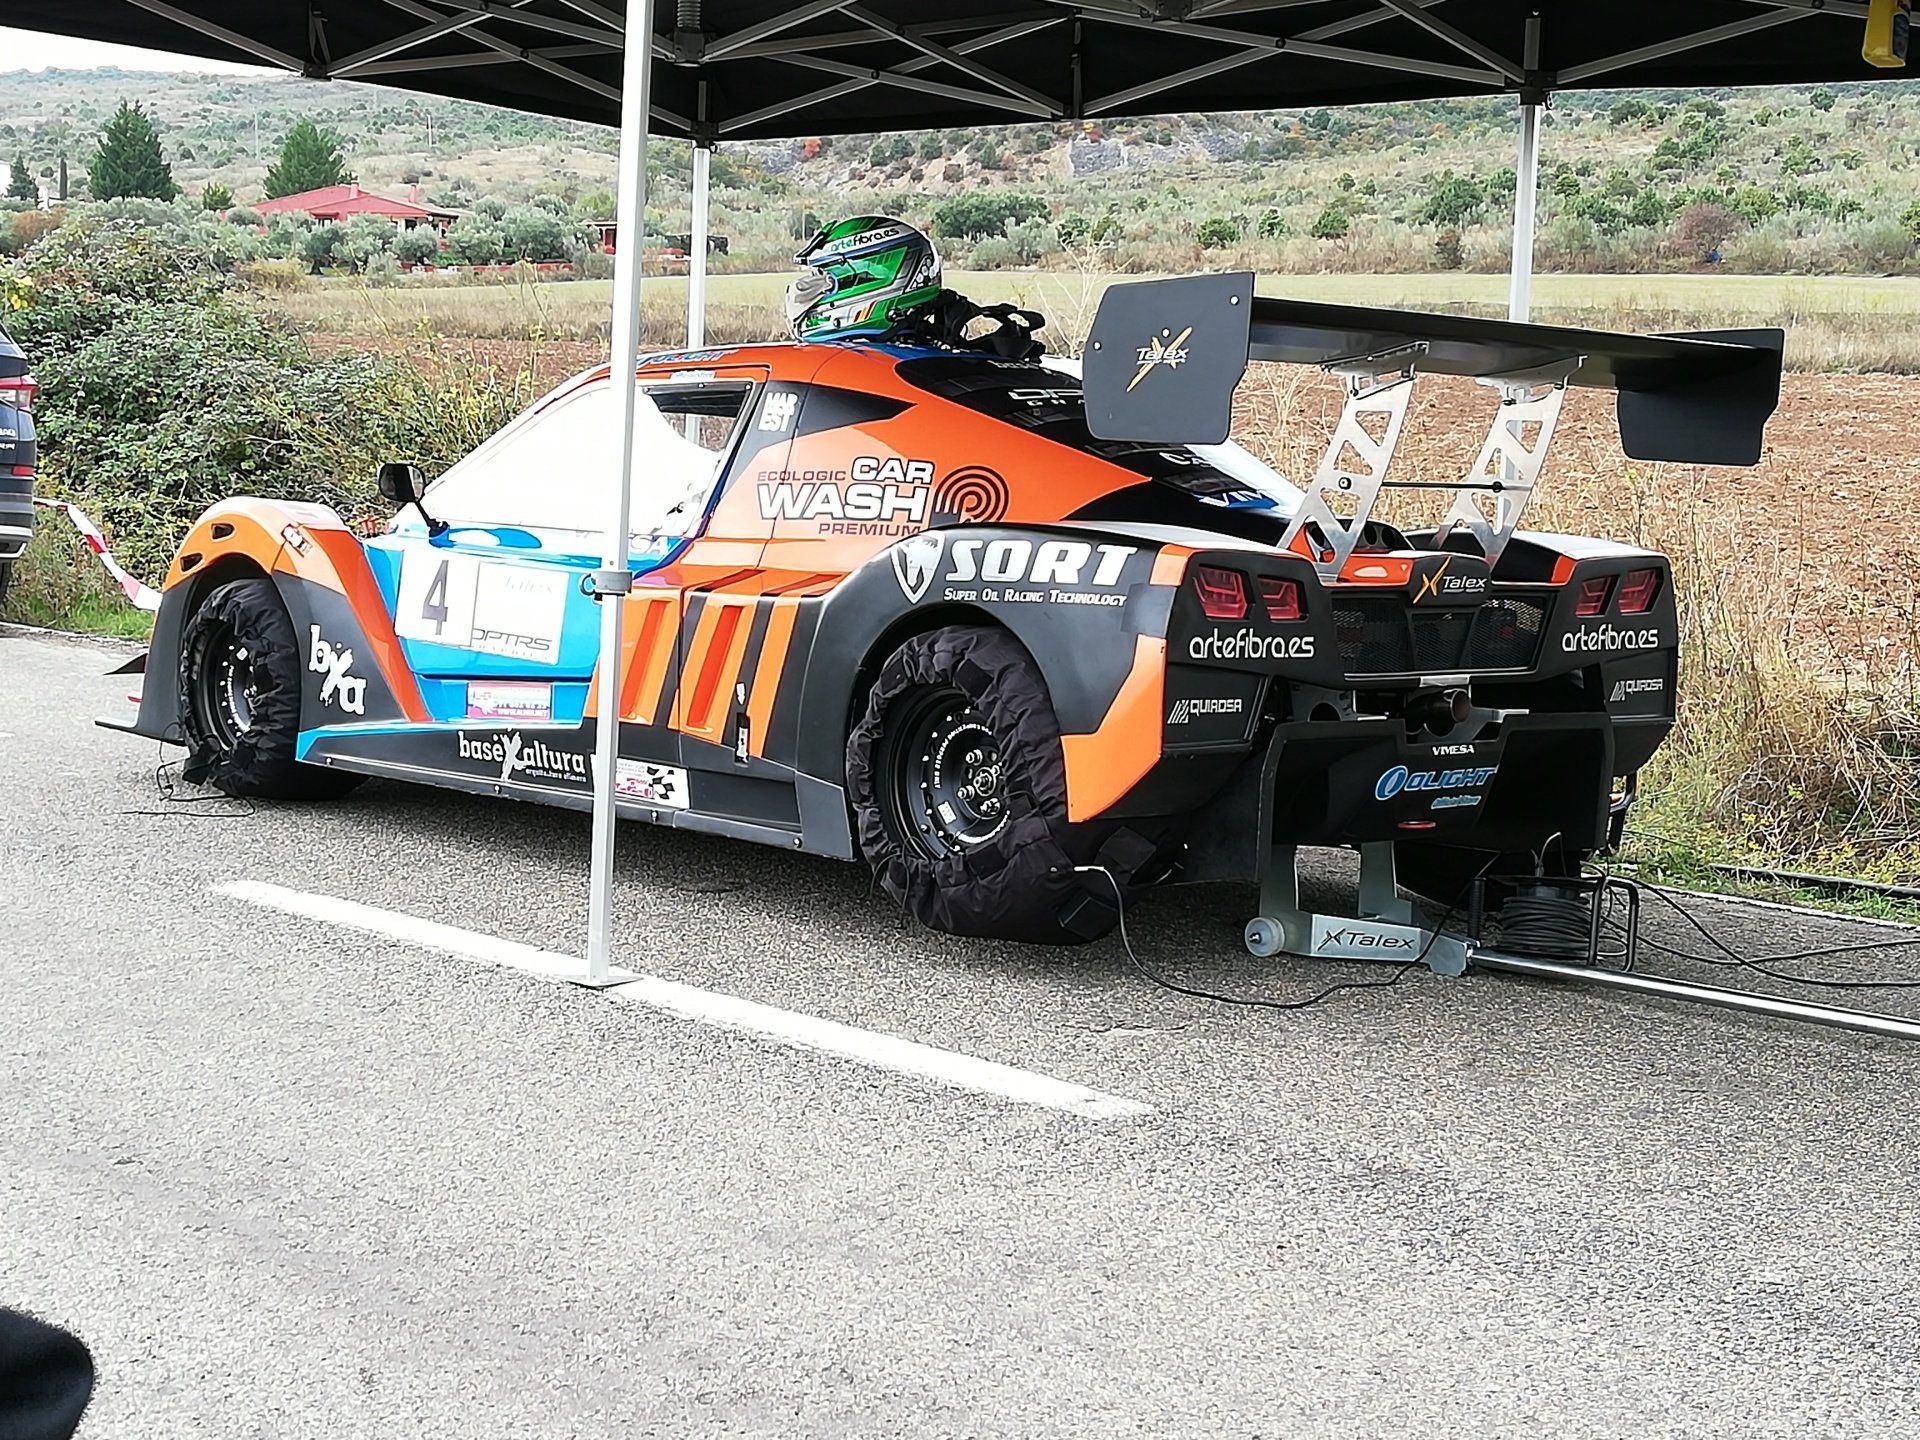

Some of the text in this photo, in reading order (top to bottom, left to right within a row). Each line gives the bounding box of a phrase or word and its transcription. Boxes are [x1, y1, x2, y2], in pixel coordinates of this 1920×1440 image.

[1136, 346, 1190, 362] Talex
[758, 456, 935, 484] ECOLOGIC CAR
[757, 483, 930, 522] WASH
[819, 523, 921, 536] PREMIUM
[945, 539, 1138, 586] SORT
[1442, 575, 1488, 589] Talex
[422, 560, 449, 636] 4
[1189, 628, 1315, 659] artefibra.es
[1562, 624, 1659, 652] artefibra.es
[1432, 744, 1475, 755] VIMESA
[1404, 765, 1499, 791] OLIGHT
[1346, 932, 1415, 950] Talex
